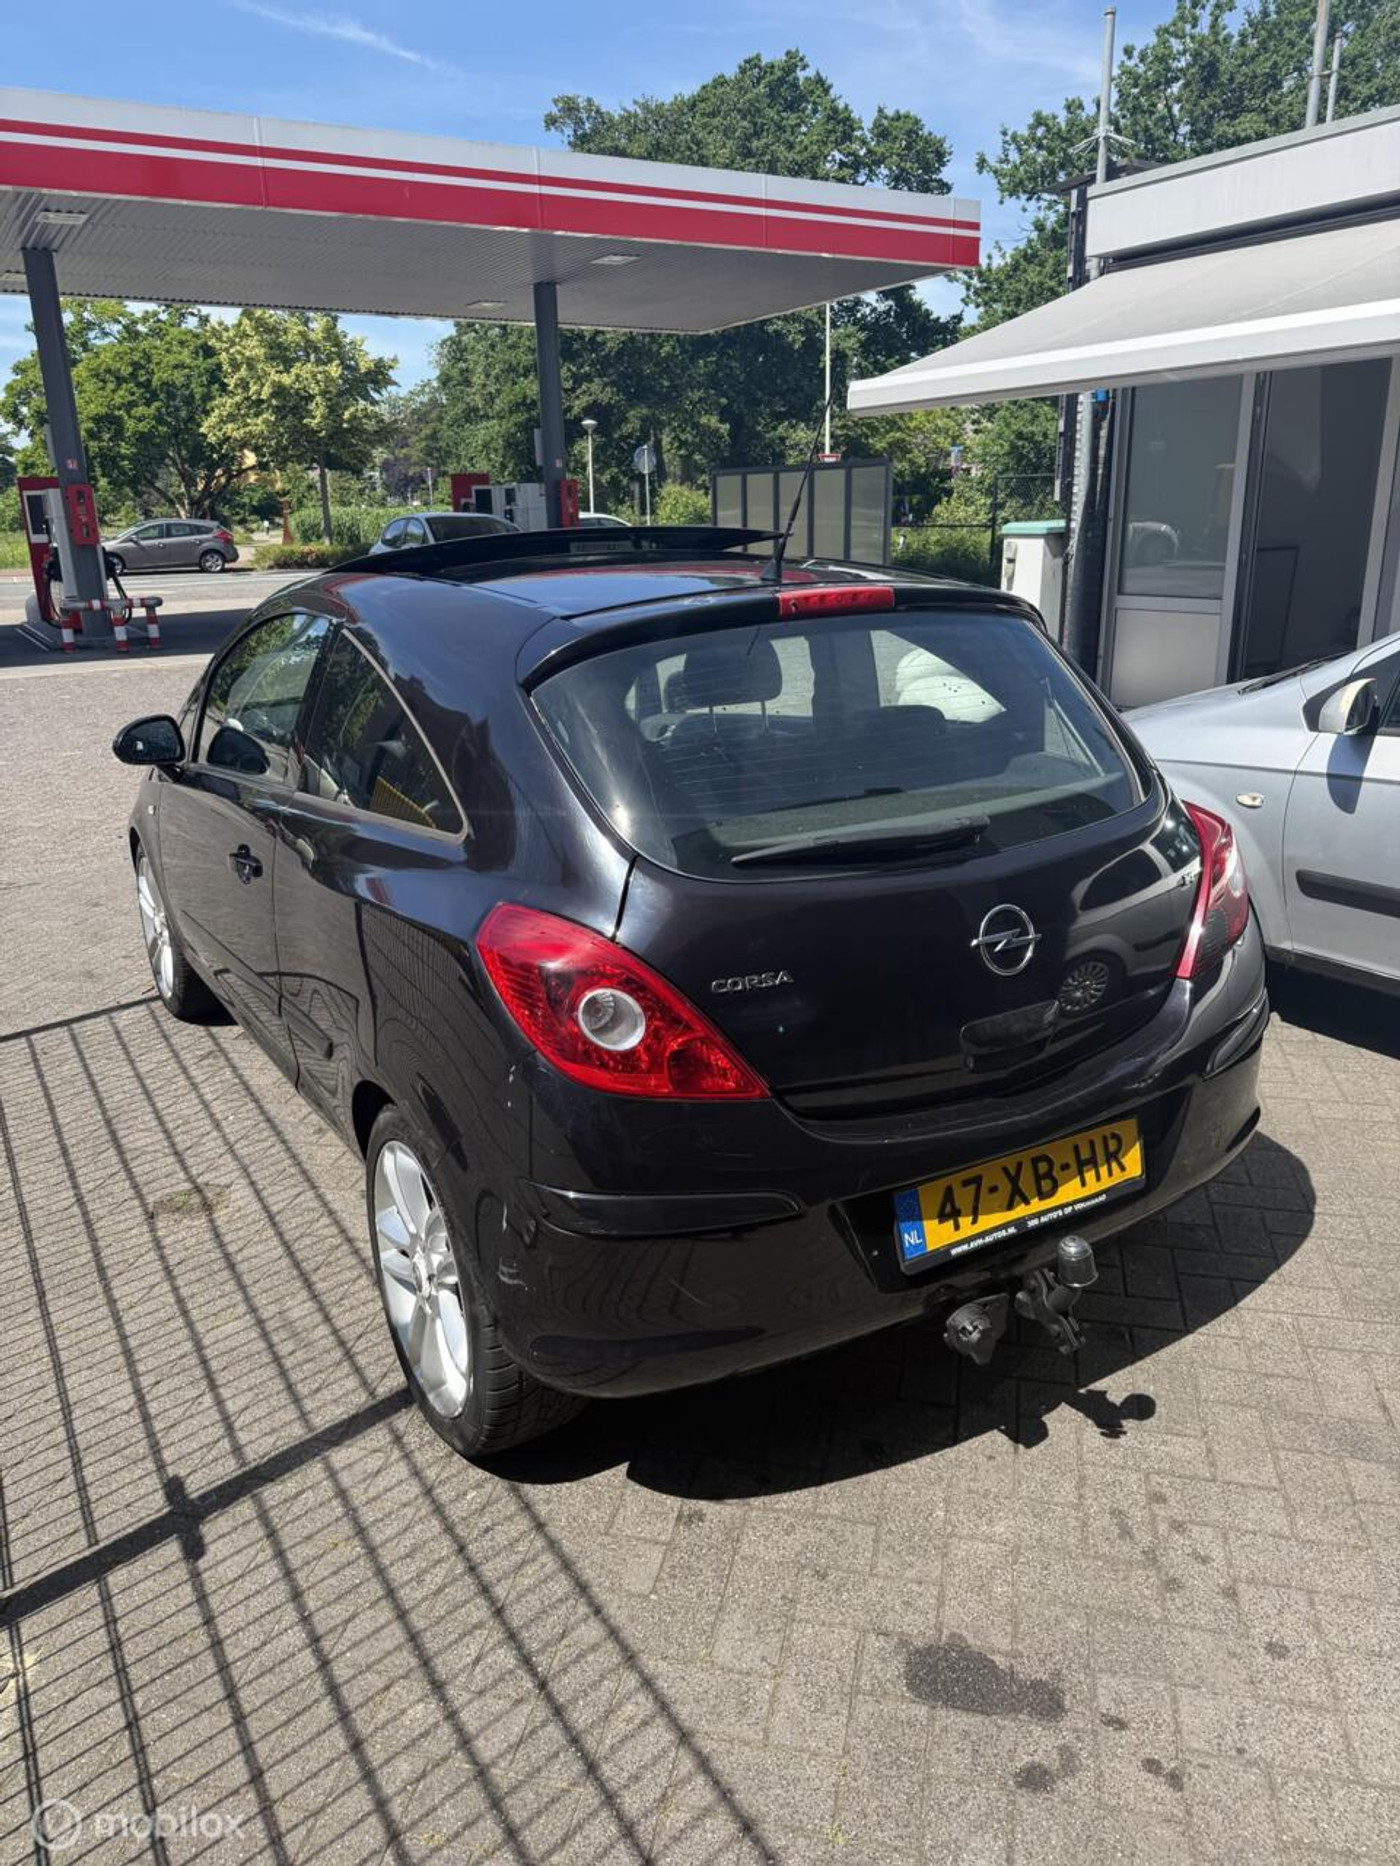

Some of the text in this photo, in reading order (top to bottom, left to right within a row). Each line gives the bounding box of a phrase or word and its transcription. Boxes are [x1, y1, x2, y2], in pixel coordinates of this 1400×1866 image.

[711, 970, 795, 993] CORSA
[936, 1131, 1127, 1232] 47-XB-HR
[904, 1229, 923, 1247] NL
